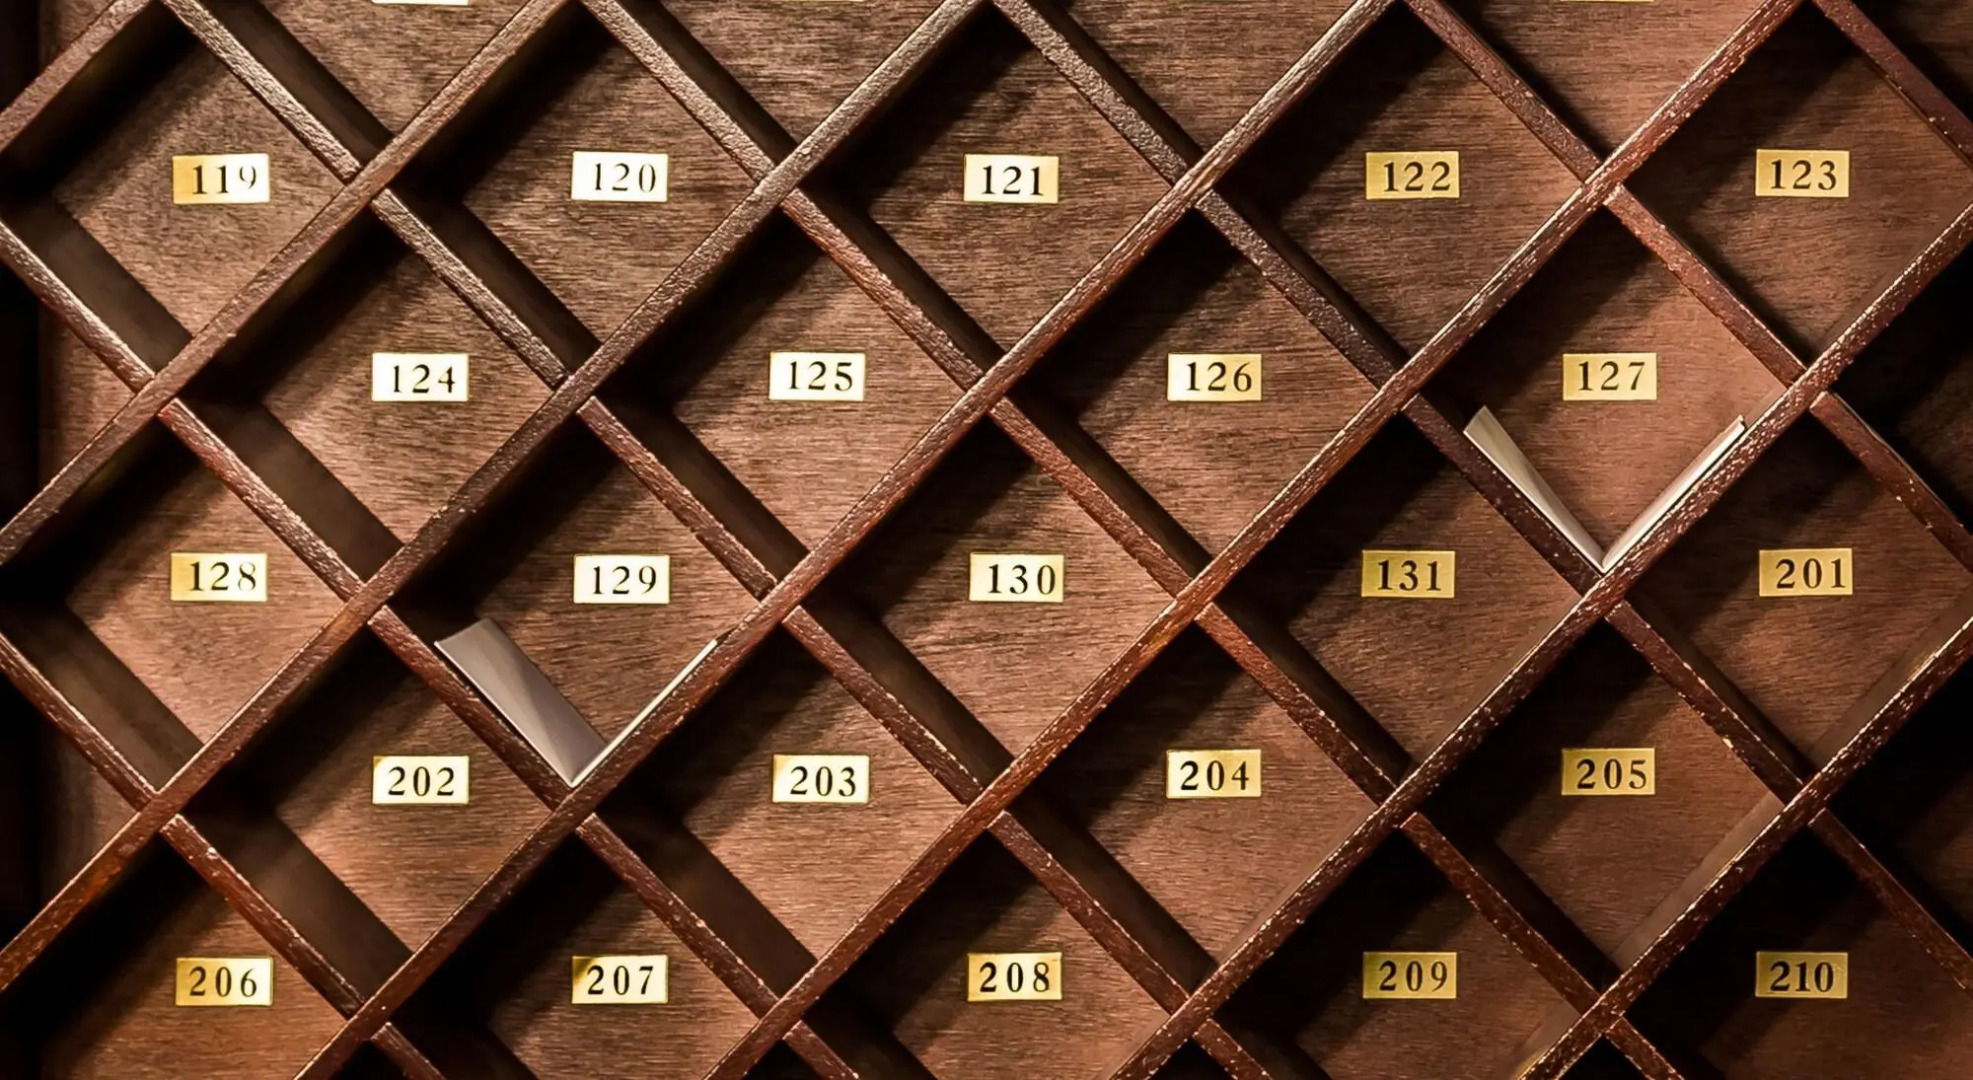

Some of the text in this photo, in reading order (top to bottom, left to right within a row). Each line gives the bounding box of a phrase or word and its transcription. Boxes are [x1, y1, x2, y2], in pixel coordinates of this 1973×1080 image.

[192, 165, 257, 195] 119
[595, 163, 656, 192] 120
[983, 166, 1043, 196] 121
[1383, 162, 1450, 192] 122
[1771, 160, 1837, 190] 123
[393, 364, 455, 394] 124
[790, 361, 853, 390] 125
[1187, 362, 1252, 393] 126
[1578, 361, 1645, 391] 127
[190, 562, 256, 592] 128
[593, 566, 657, 595] 129
[988, 564, 1056, 595] 130
[1377, 560, 1441, 591] 131
[1775, 559, 1845, 589] 201
[389, 767, 455, 797] 202
[791, 766, 856, 797] 203
[1180, 760, 1250, 791] 204
[1576, 759, 1647, 790] 205
[188, 966, 257, 998] 206
[586, 965, 654, 996] 207
[979, 962, 1050, 993] 208
[1378, 960, 1448, 992] 209
[1769, 961, 1835, 993] 210
